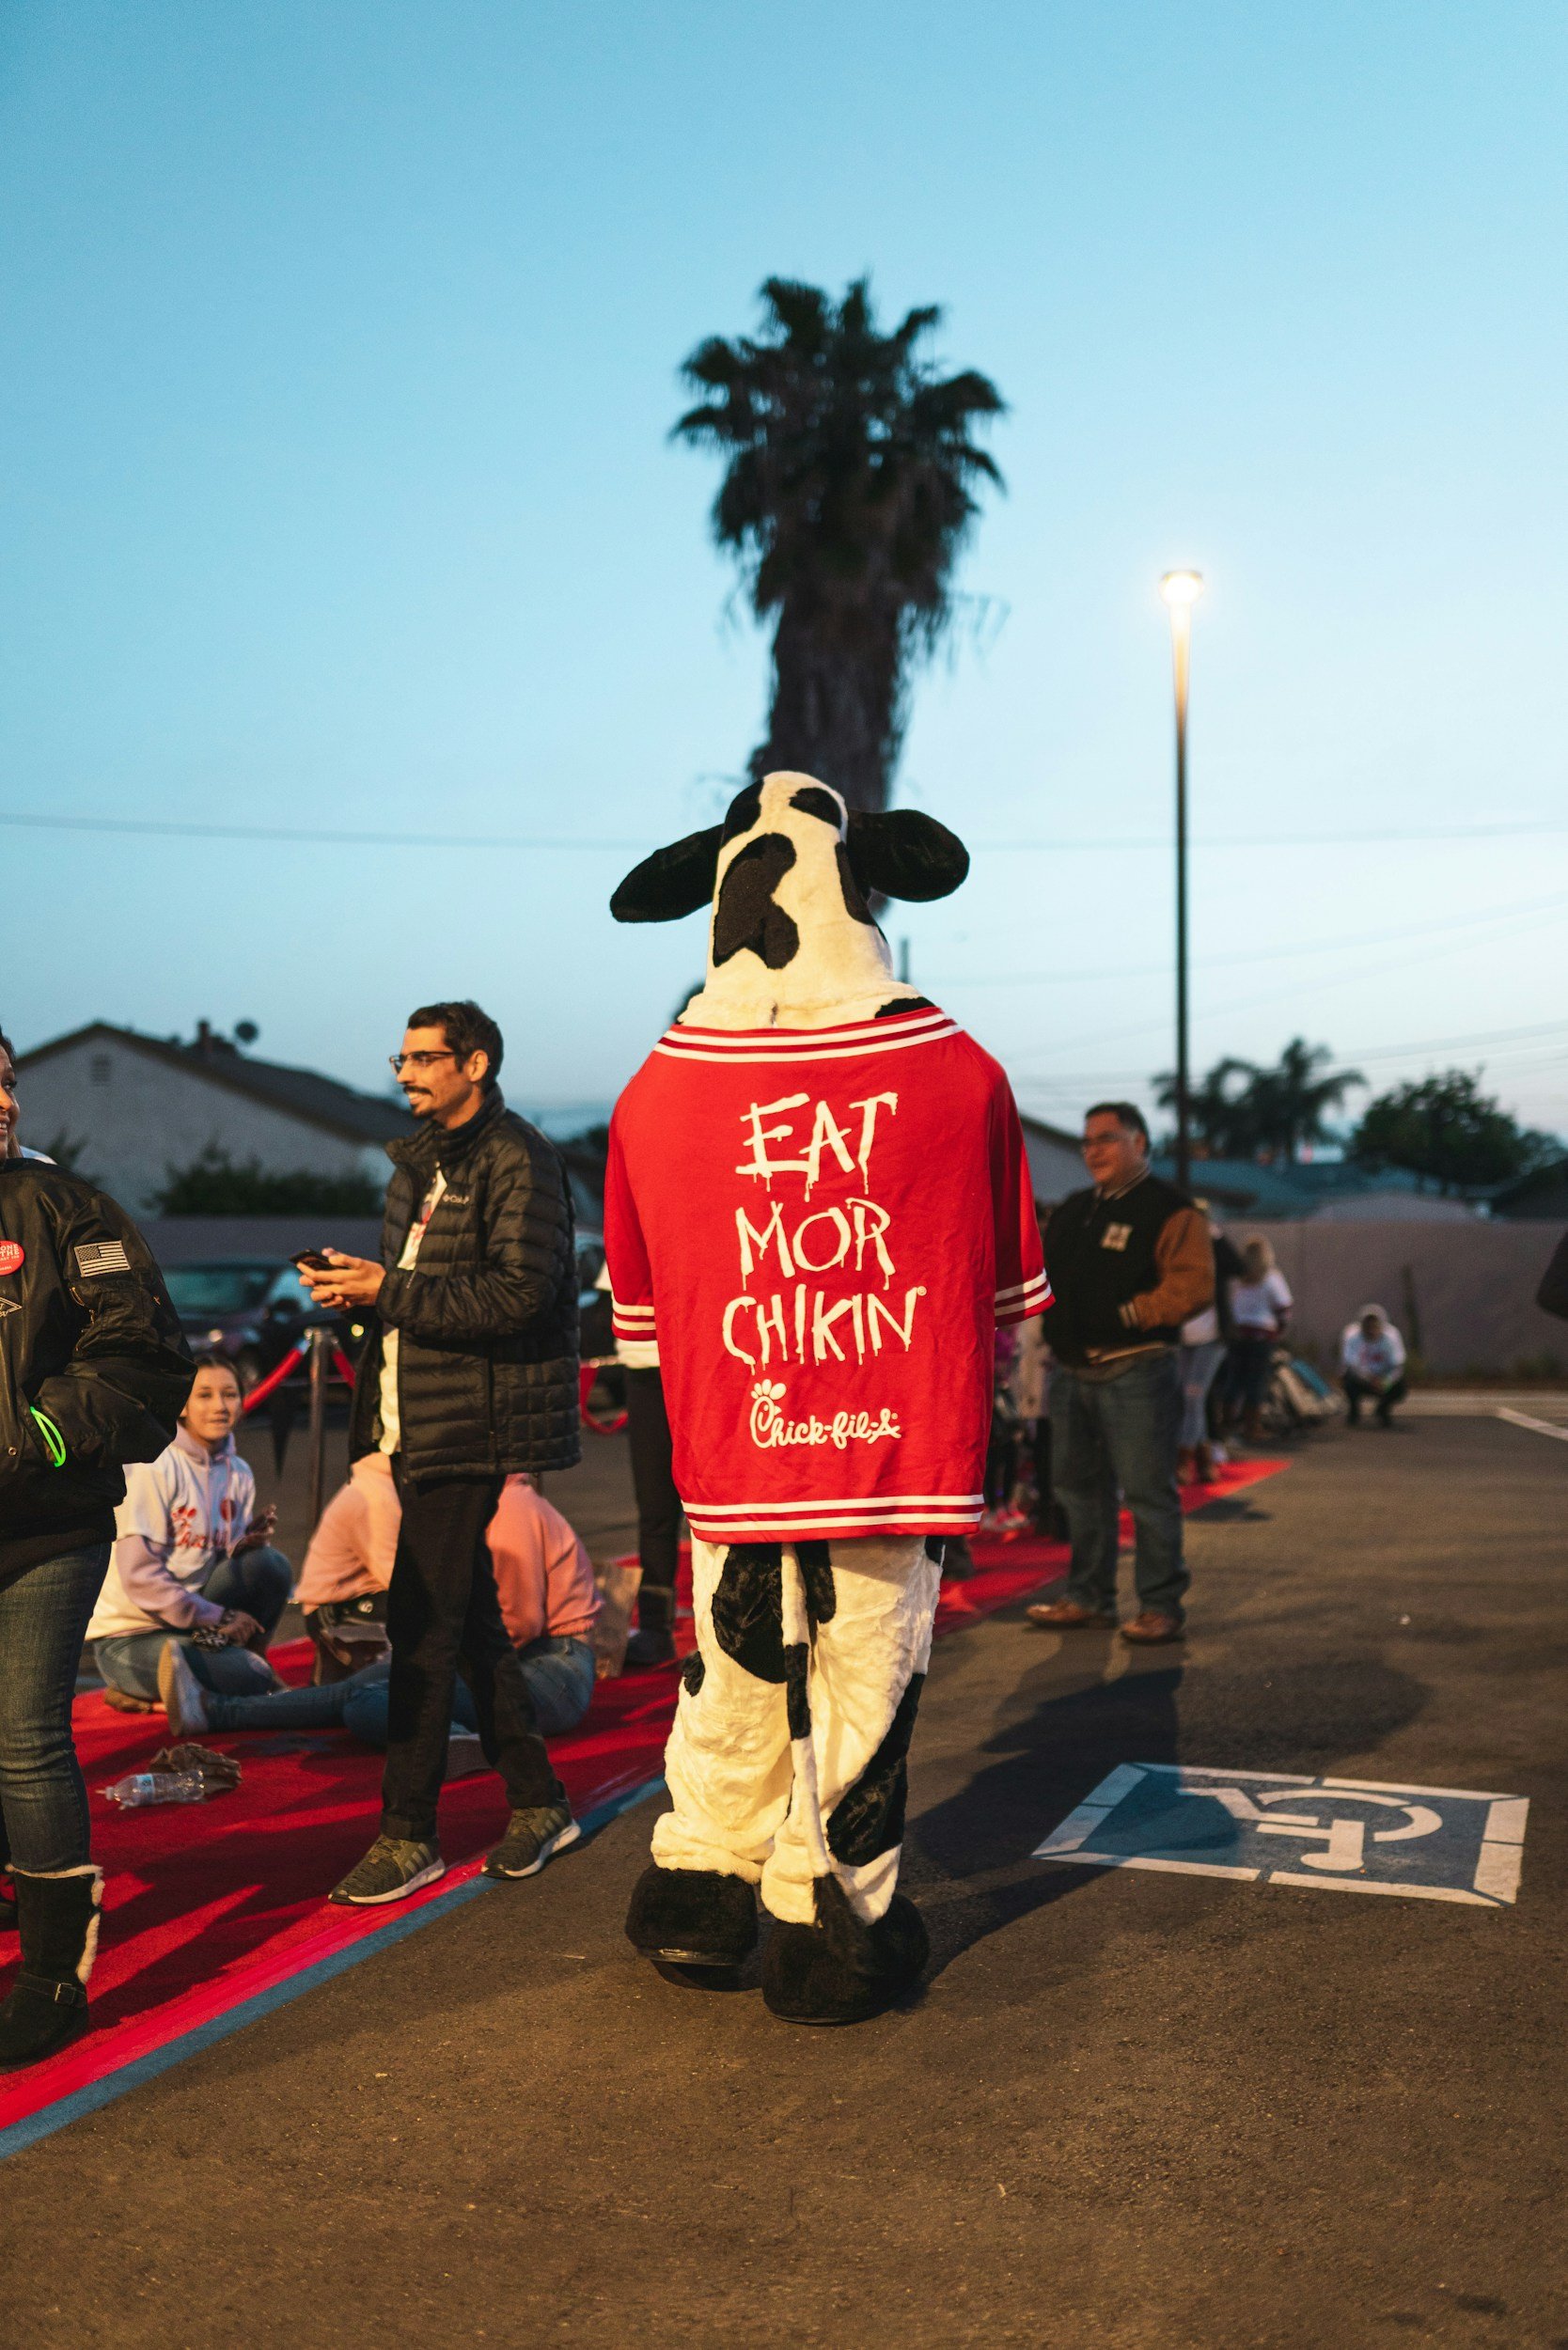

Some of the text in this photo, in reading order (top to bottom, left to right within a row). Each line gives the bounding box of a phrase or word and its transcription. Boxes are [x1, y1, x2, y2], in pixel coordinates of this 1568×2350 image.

[735, 1091, 899, 1203] EAT
[735, 1197, 896, 1292] MOR
[722, 1284, 918, 1376] CHIKIN
[749, 1395, 902, 1449] Chick-fil-A
